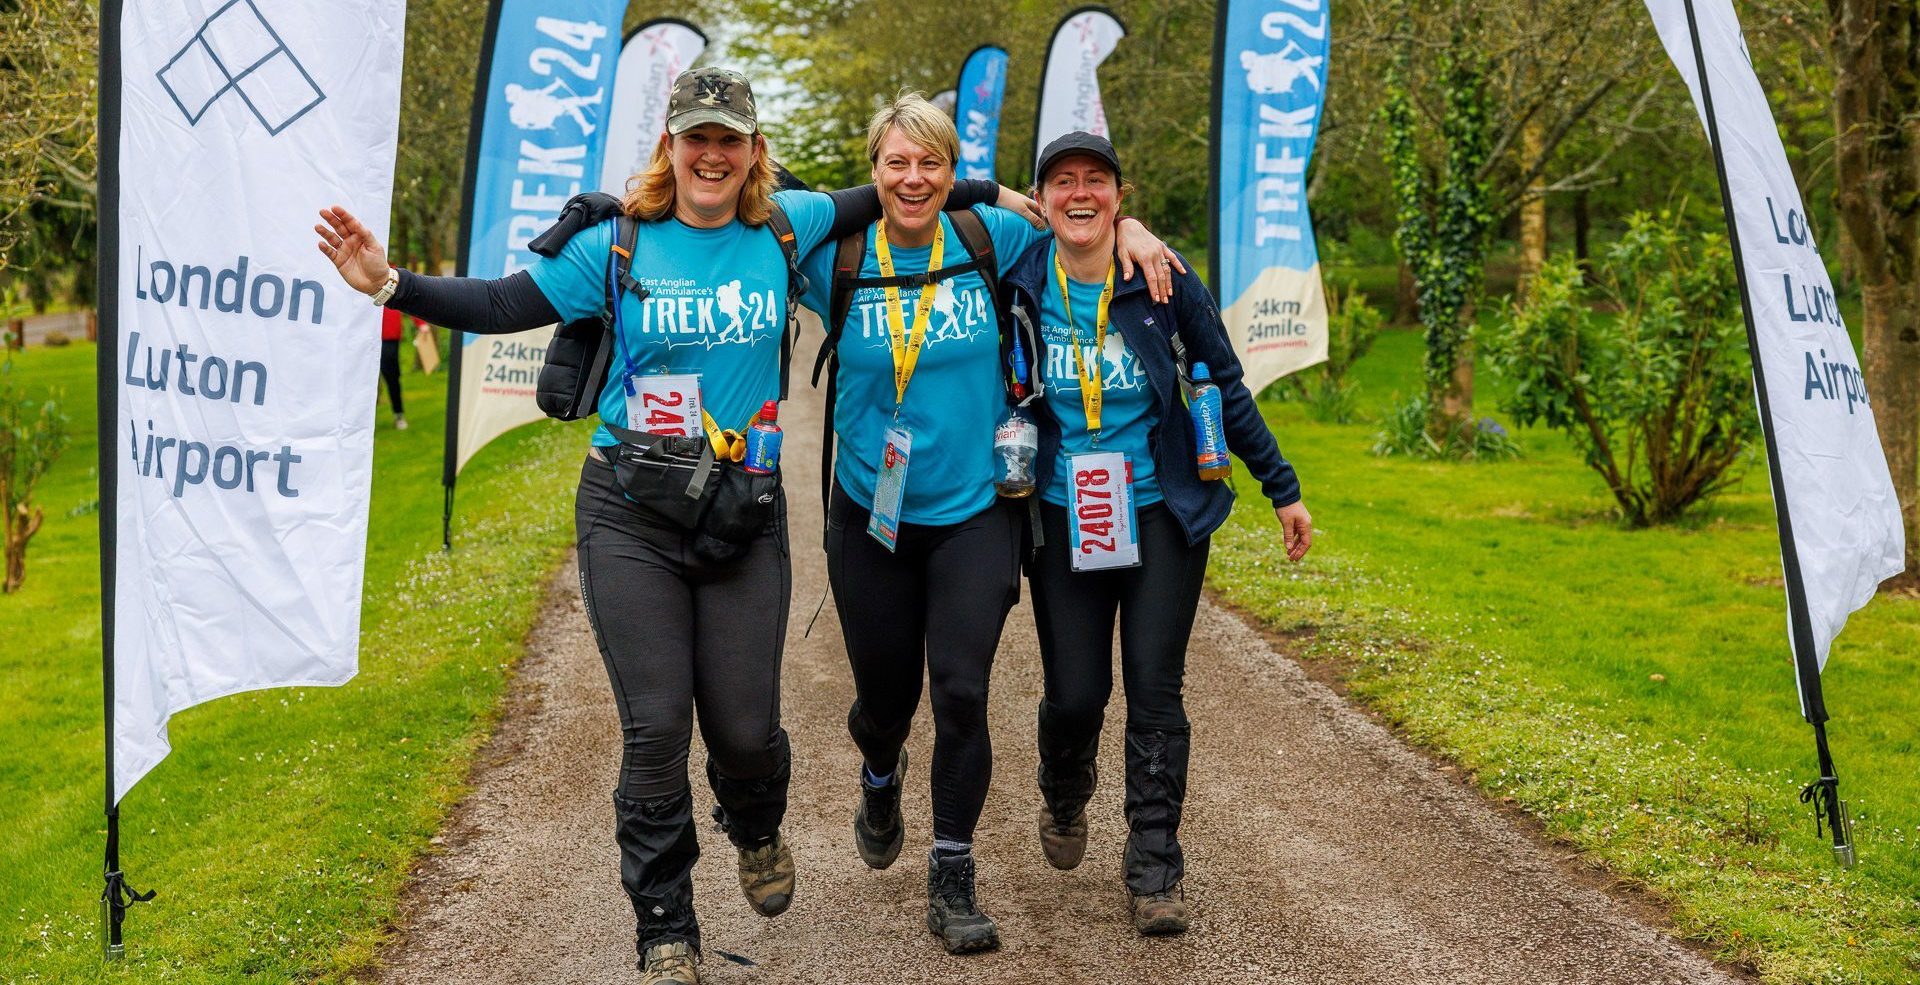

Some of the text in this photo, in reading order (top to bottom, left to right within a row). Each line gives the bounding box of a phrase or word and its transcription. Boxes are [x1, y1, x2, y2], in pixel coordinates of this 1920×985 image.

[1261, 0, 1327, 40] 2
[529, 16, 607, 80] 24
[695, 74, 733, 103] NY
[640, 277, 696, 288] East Anglian
[655, 286, 713, 296] Ambulance's
[642, 289, 777, 334] TREK 24
[961, 288, 988, 327] 24
[126, 331, 268, 406] Luton
[1047, 343, 1099, 380] REK
[1075, 469, 1116, 554] 24078
